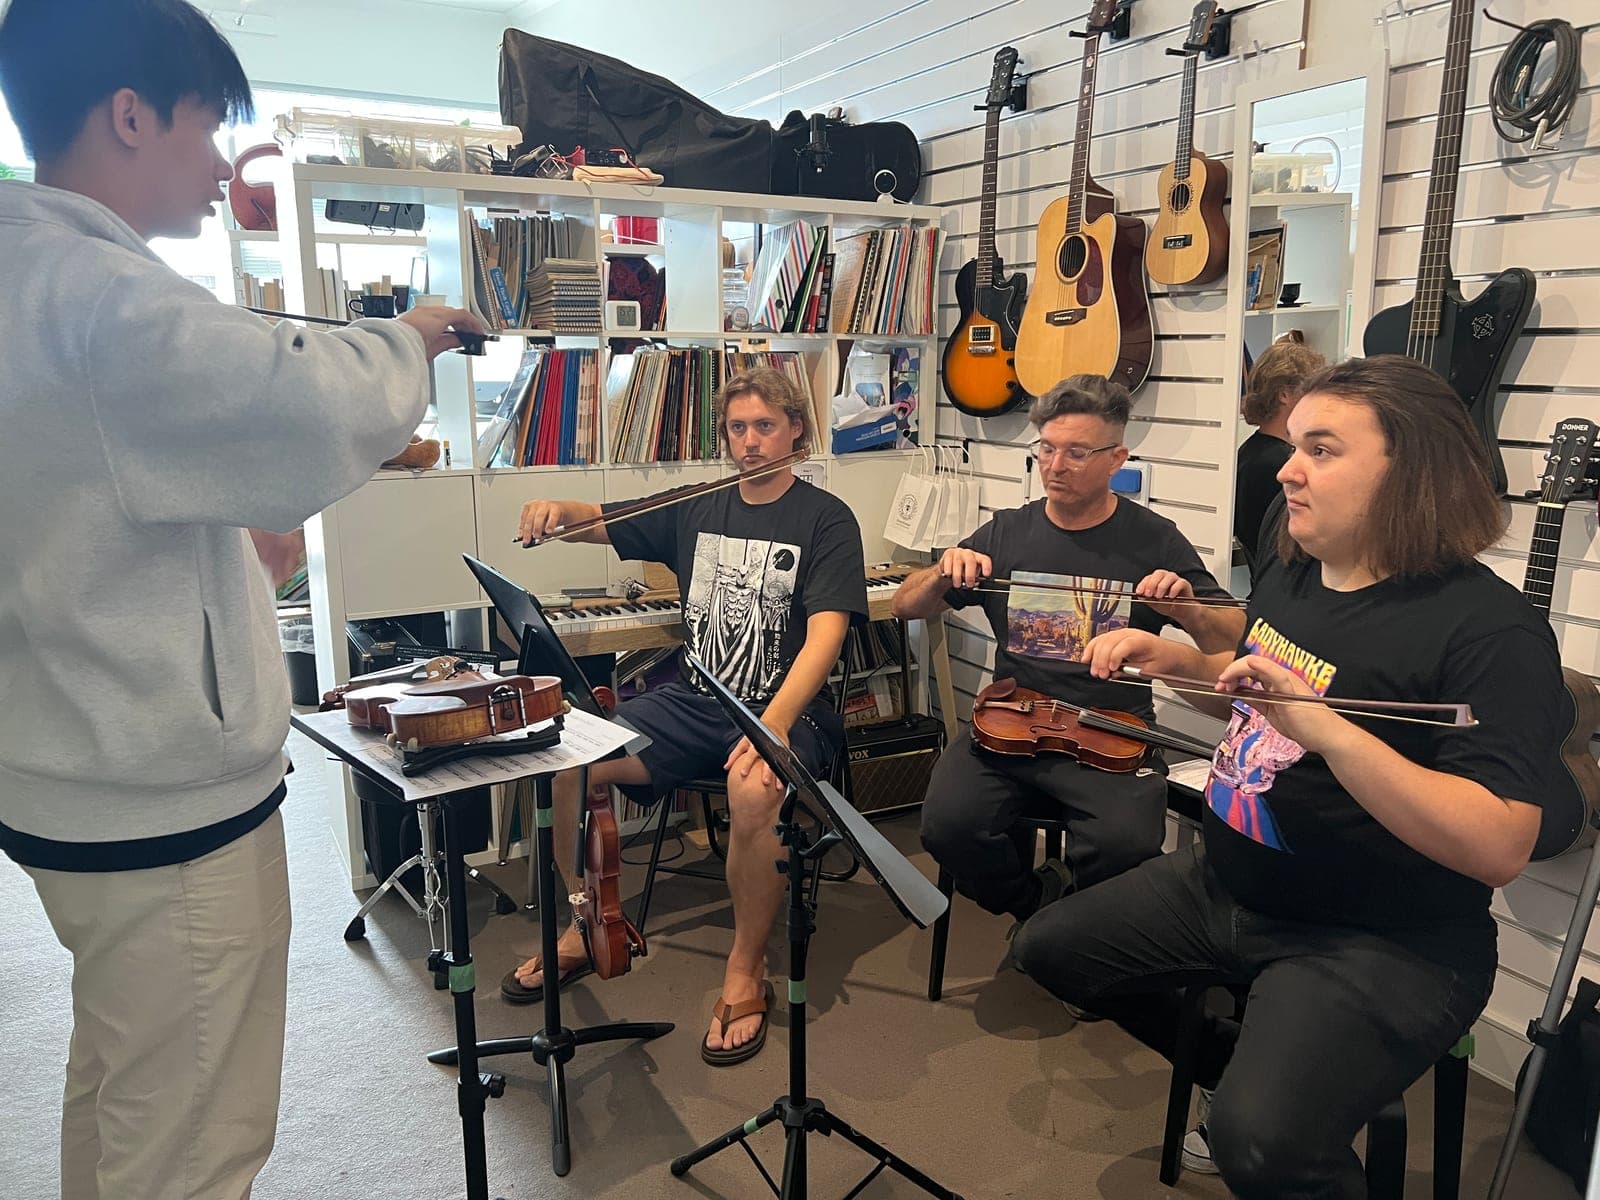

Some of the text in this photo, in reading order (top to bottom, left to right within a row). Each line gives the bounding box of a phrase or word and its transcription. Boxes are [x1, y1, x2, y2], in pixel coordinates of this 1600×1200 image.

[1562, 423, 1589, 431] DONNER
[1245, 617, 1337, 692] LADYHAWKE
[848, 749, 869, 760] VOX
